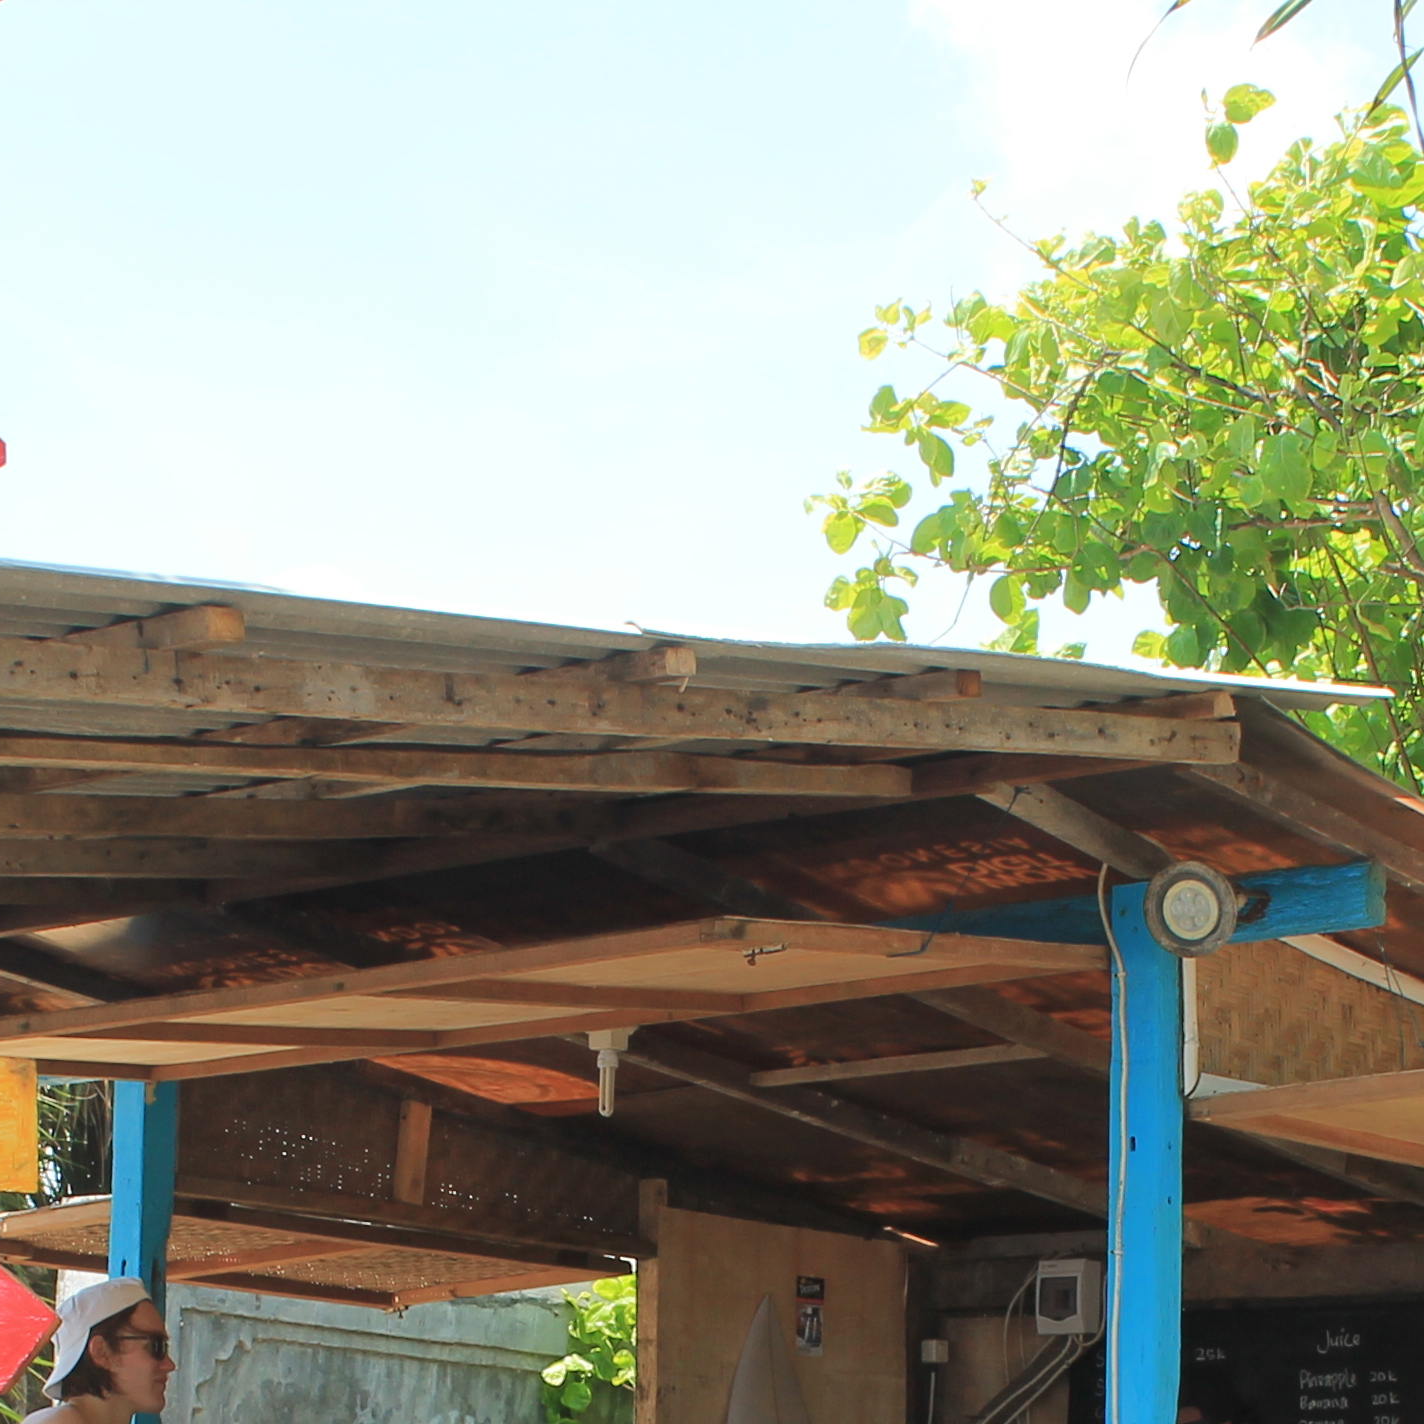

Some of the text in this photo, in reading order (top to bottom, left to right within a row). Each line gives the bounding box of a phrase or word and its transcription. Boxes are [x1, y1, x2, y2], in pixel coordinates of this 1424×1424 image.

[1317, 1328, 1360, 1354] Juice
[1299, 1368, 1357, 1391] Pineapple
[1299, 1394, 1349, 1410] Banana
